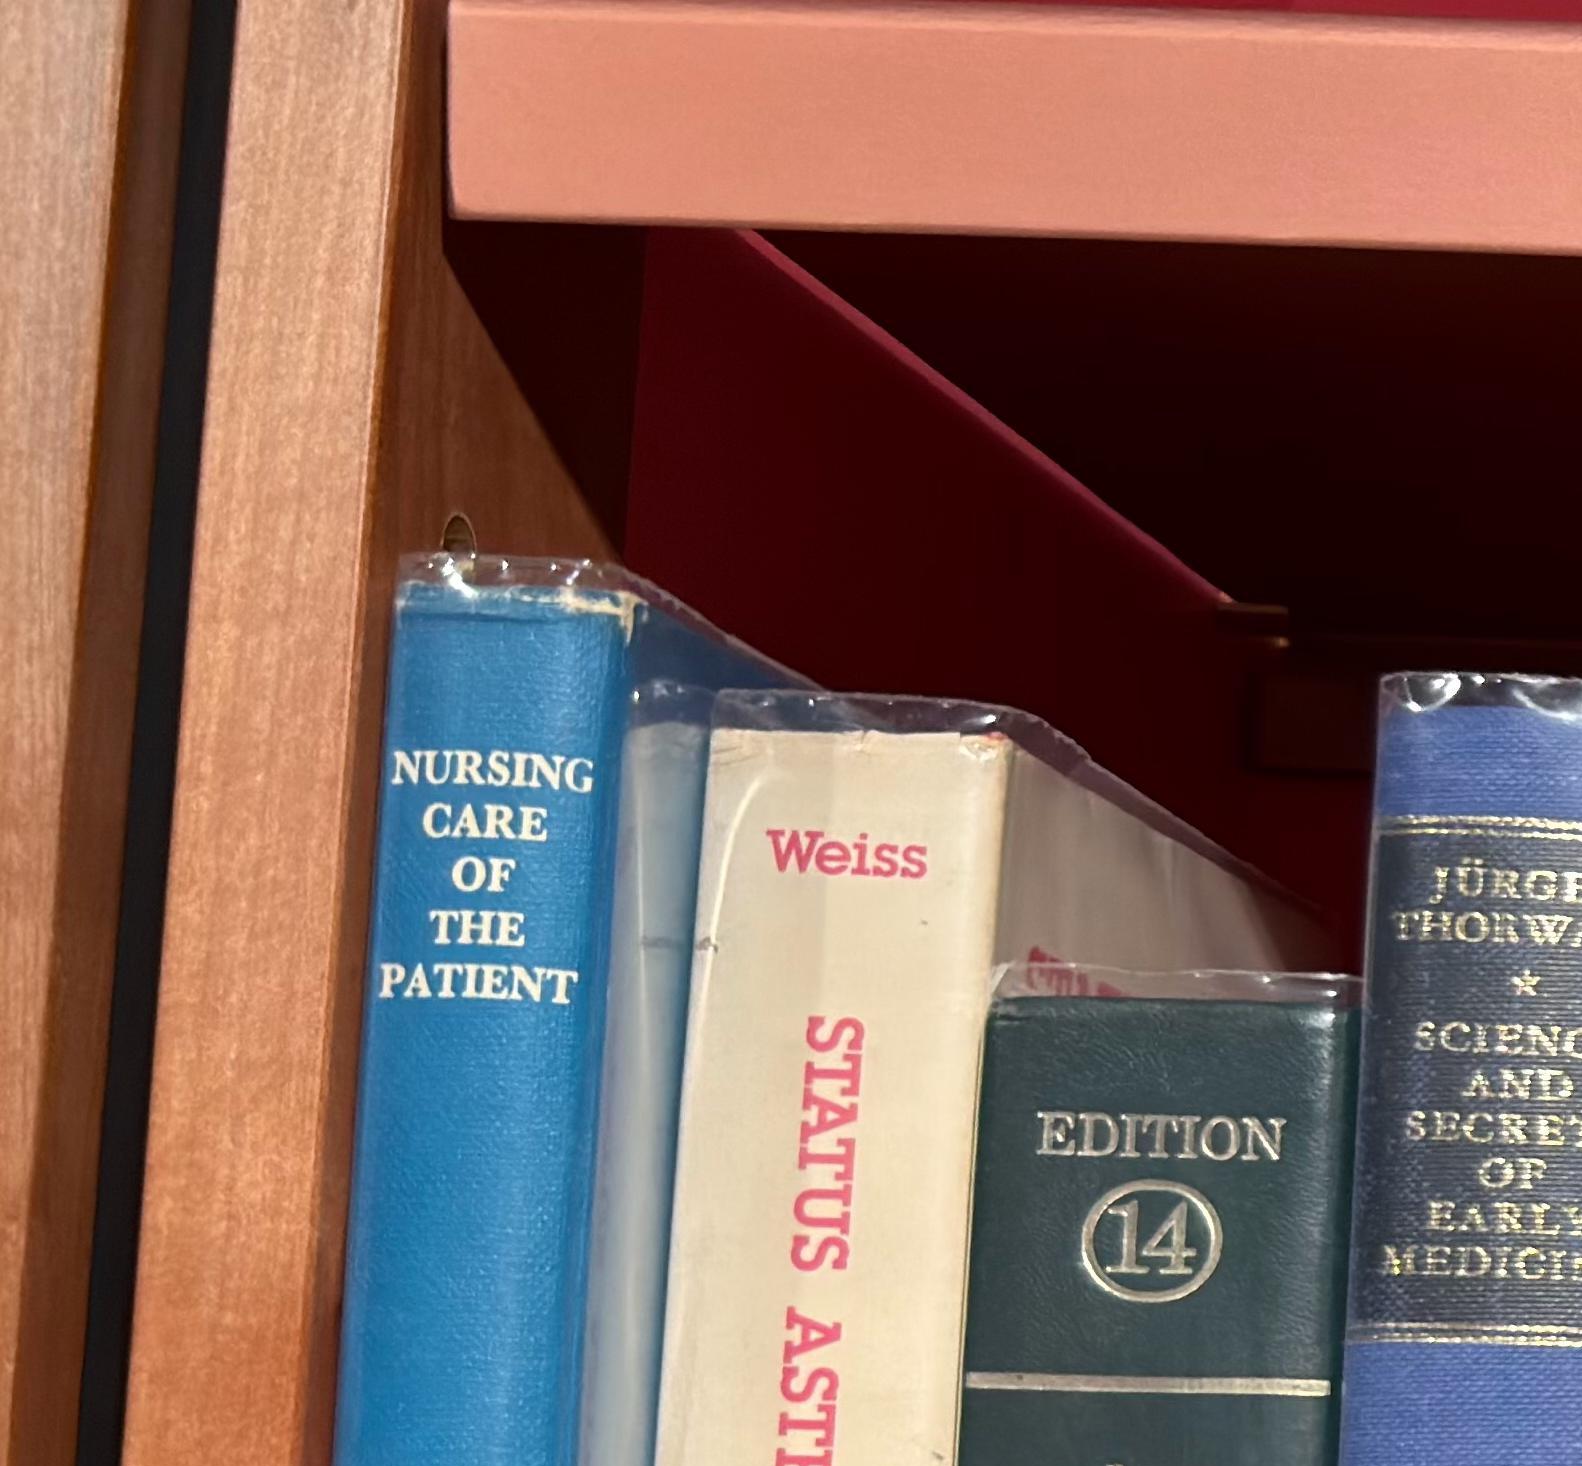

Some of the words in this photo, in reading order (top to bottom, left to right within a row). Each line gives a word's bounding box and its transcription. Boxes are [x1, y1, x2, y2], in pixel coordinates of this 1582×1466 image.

[391, 749, 594, 793] NURSING
[421, 804, 548, 841] CARE
[451, 856, 512, 893] OF
[766, 829, 927, 879] Weiss
[431, 911, 525, 948] THE
[378, 964, 578, 1005] PATIENT
[1462, 1069, 1575, 1101] AND
[789, 1015, 865, 1273] STATUS
[1035, 1111, 1286, 1160] EDITION
[1478, 1157, 1547, 1190] OF
[1106, 1201, 1198, 1274] 14
